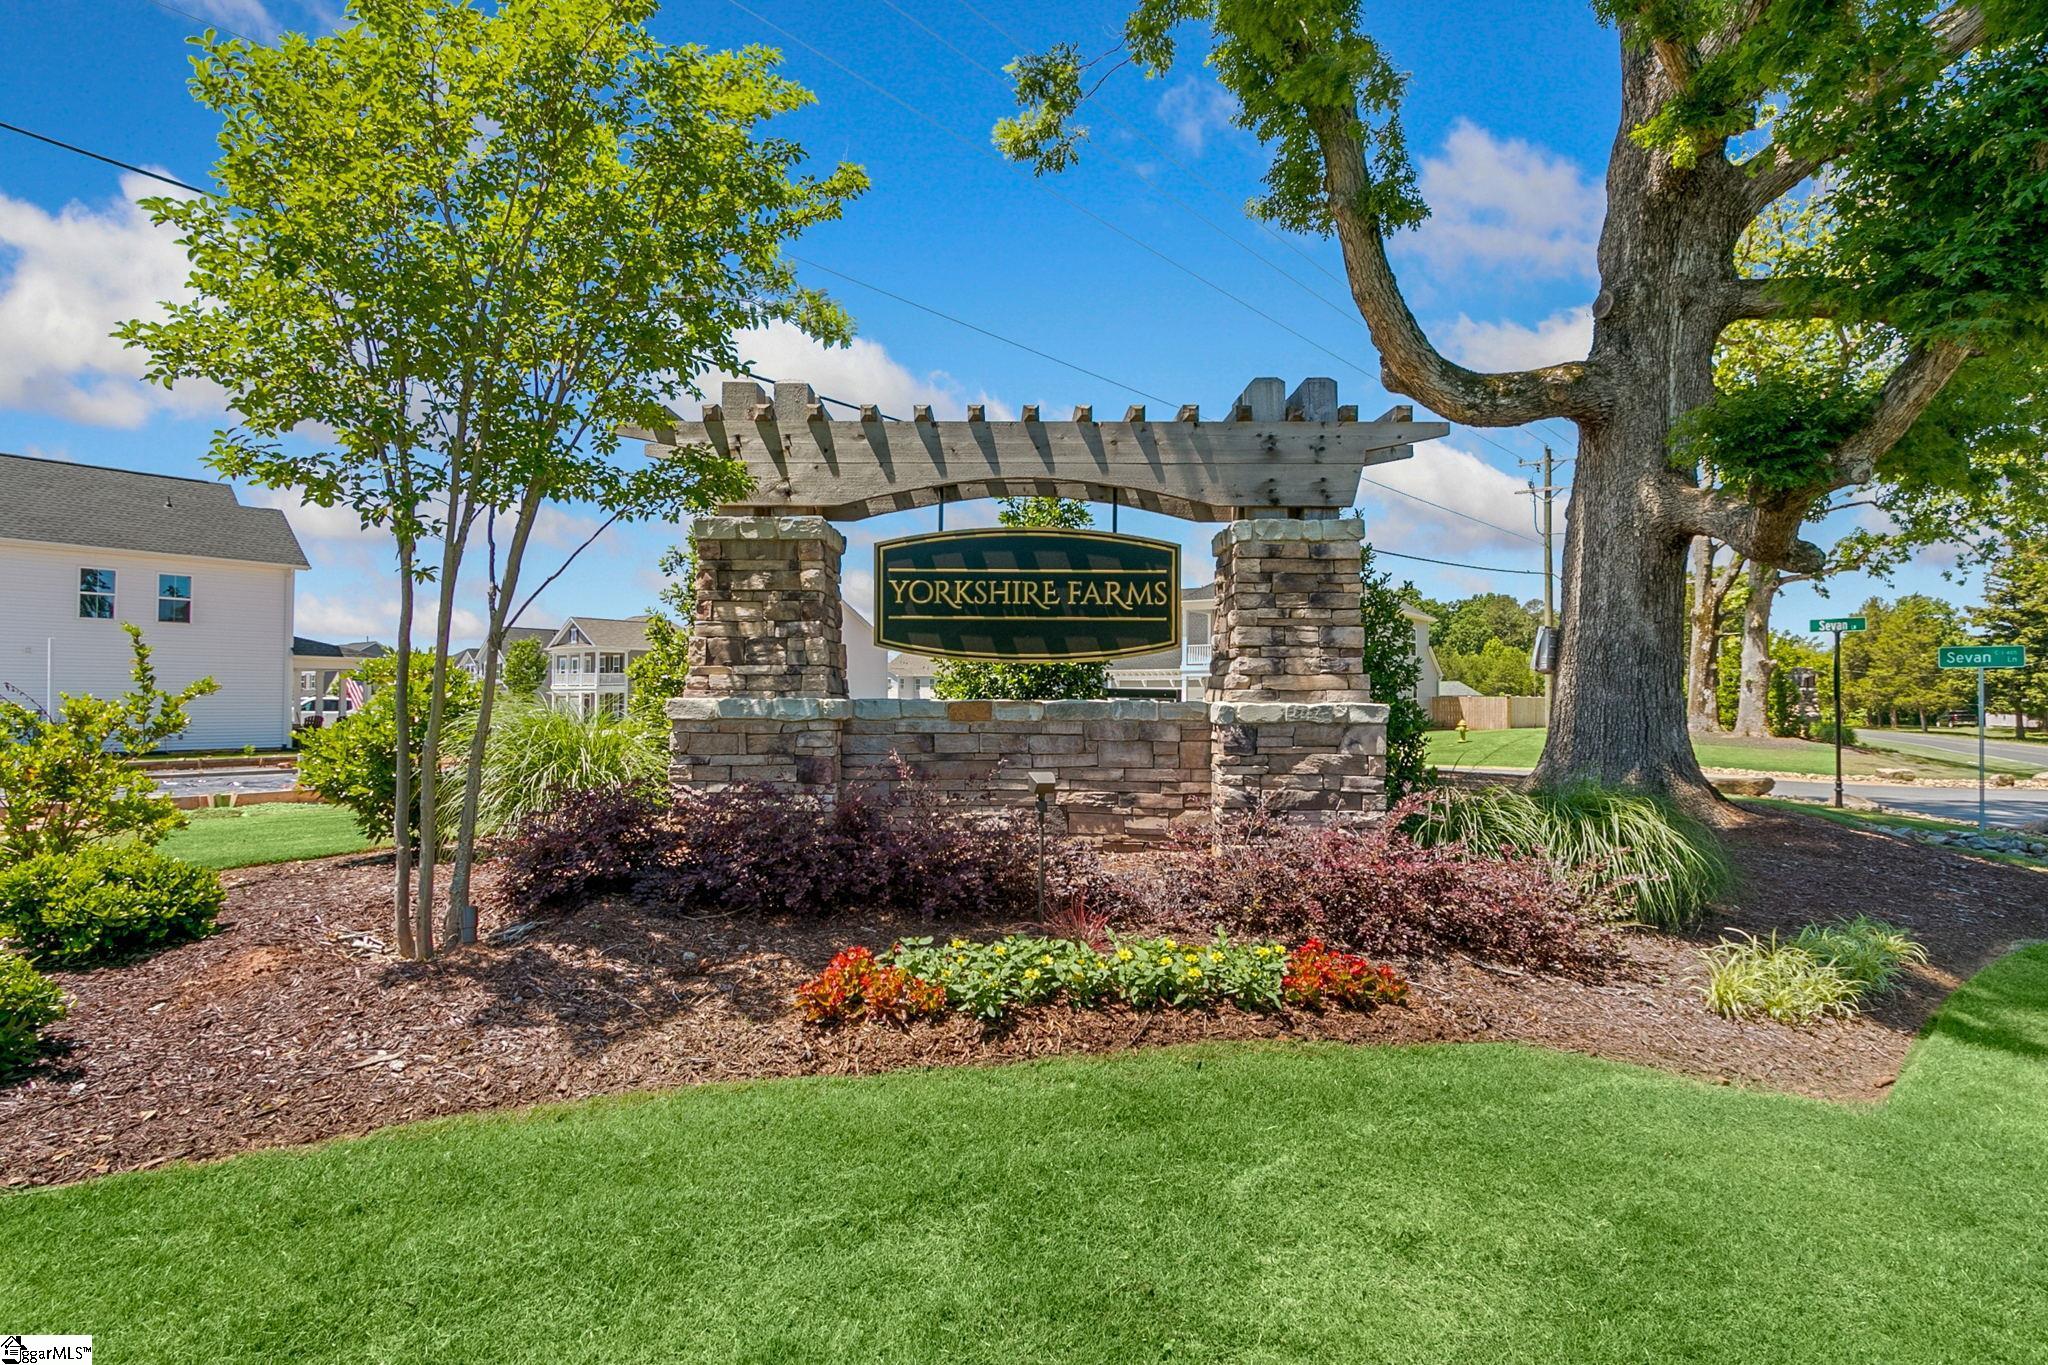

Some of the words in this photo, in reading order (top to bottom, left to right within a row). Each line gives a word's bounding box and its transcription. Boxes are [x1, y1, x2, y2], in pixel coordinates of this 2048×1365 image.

[888, 579, 1060, 609] YORKSHIRE
[1067, 581, 1168, 610] FARMS
[1818, 620, 1848, 631] Sevan
[1946, 651, 1992, 663] Sevan
